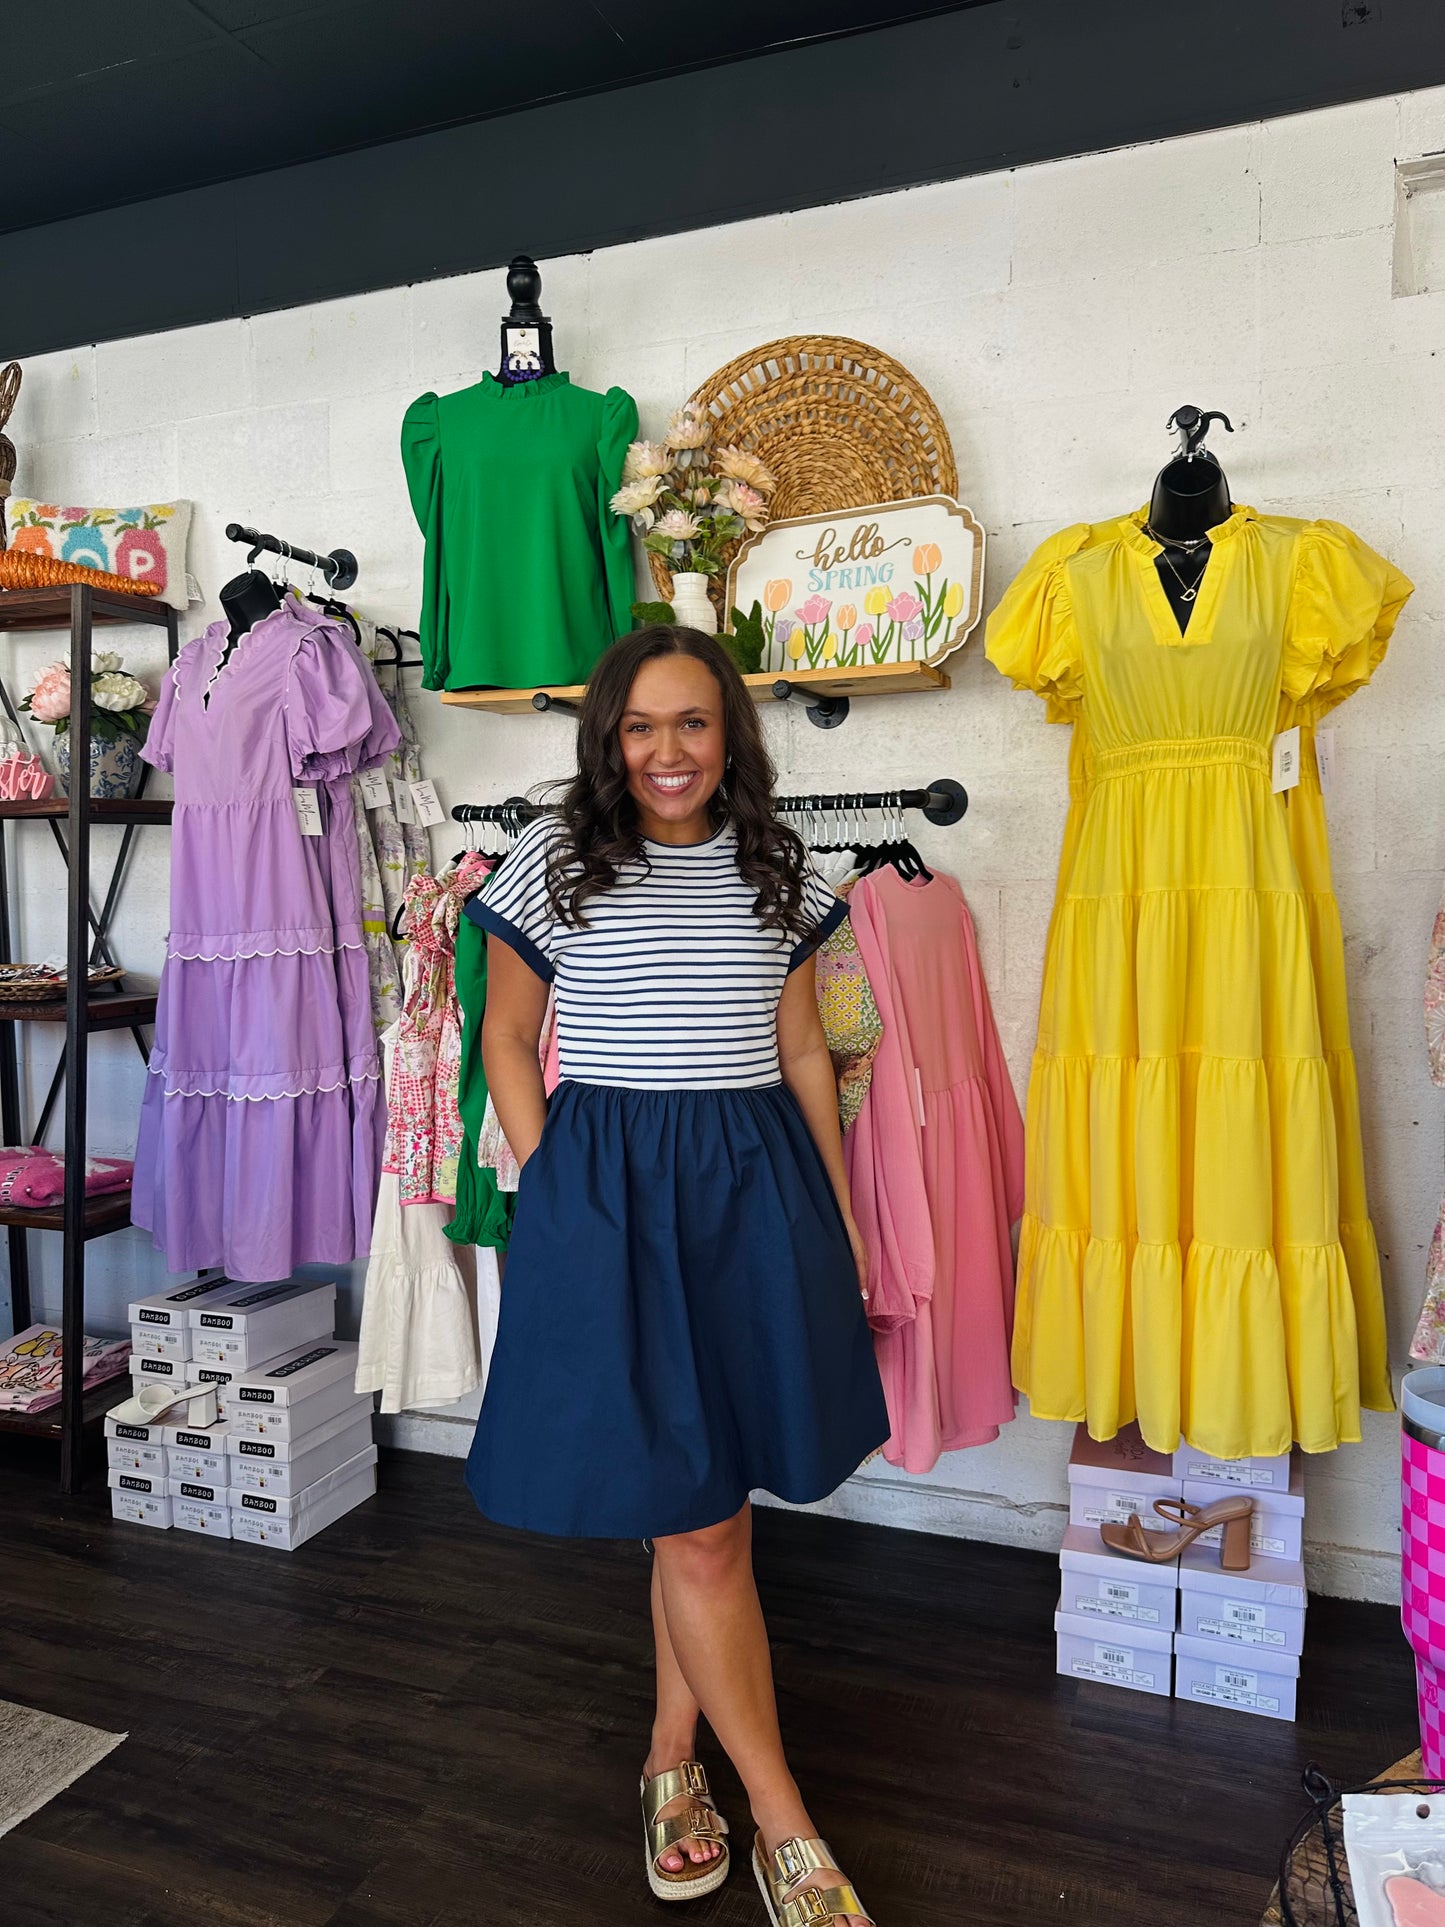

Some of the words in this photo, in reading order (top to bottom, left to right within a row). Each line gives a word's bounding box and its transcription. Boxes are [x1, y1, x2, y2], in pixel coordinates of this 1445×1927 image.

[796, 523, 912, 571] hello
[808, 562, 894, 592] SPRING
[0, 751, 48, 800] ster
[140, 1311, 168, 1322] BAMBOO
[202, 1316, 231, 1327] BAMBOO
[142, 1361, 171, 1372] BAMBOO
[200, 1372, 230, 1382] BAMBOO
[241, 1390, 272, 1400] BAMBOO
[117, 1427, 147, 1438] BAMBOO
[178, 1435, 208, 1446] BAMBOO
[241, 1444, 273, 1455] BAMBOO
[121, 1478, 150, 1490] BAMBOO
[182, 1486, 212, 1498] BAMBOO
[243, 1497, 274, 1510] BAMBOO
